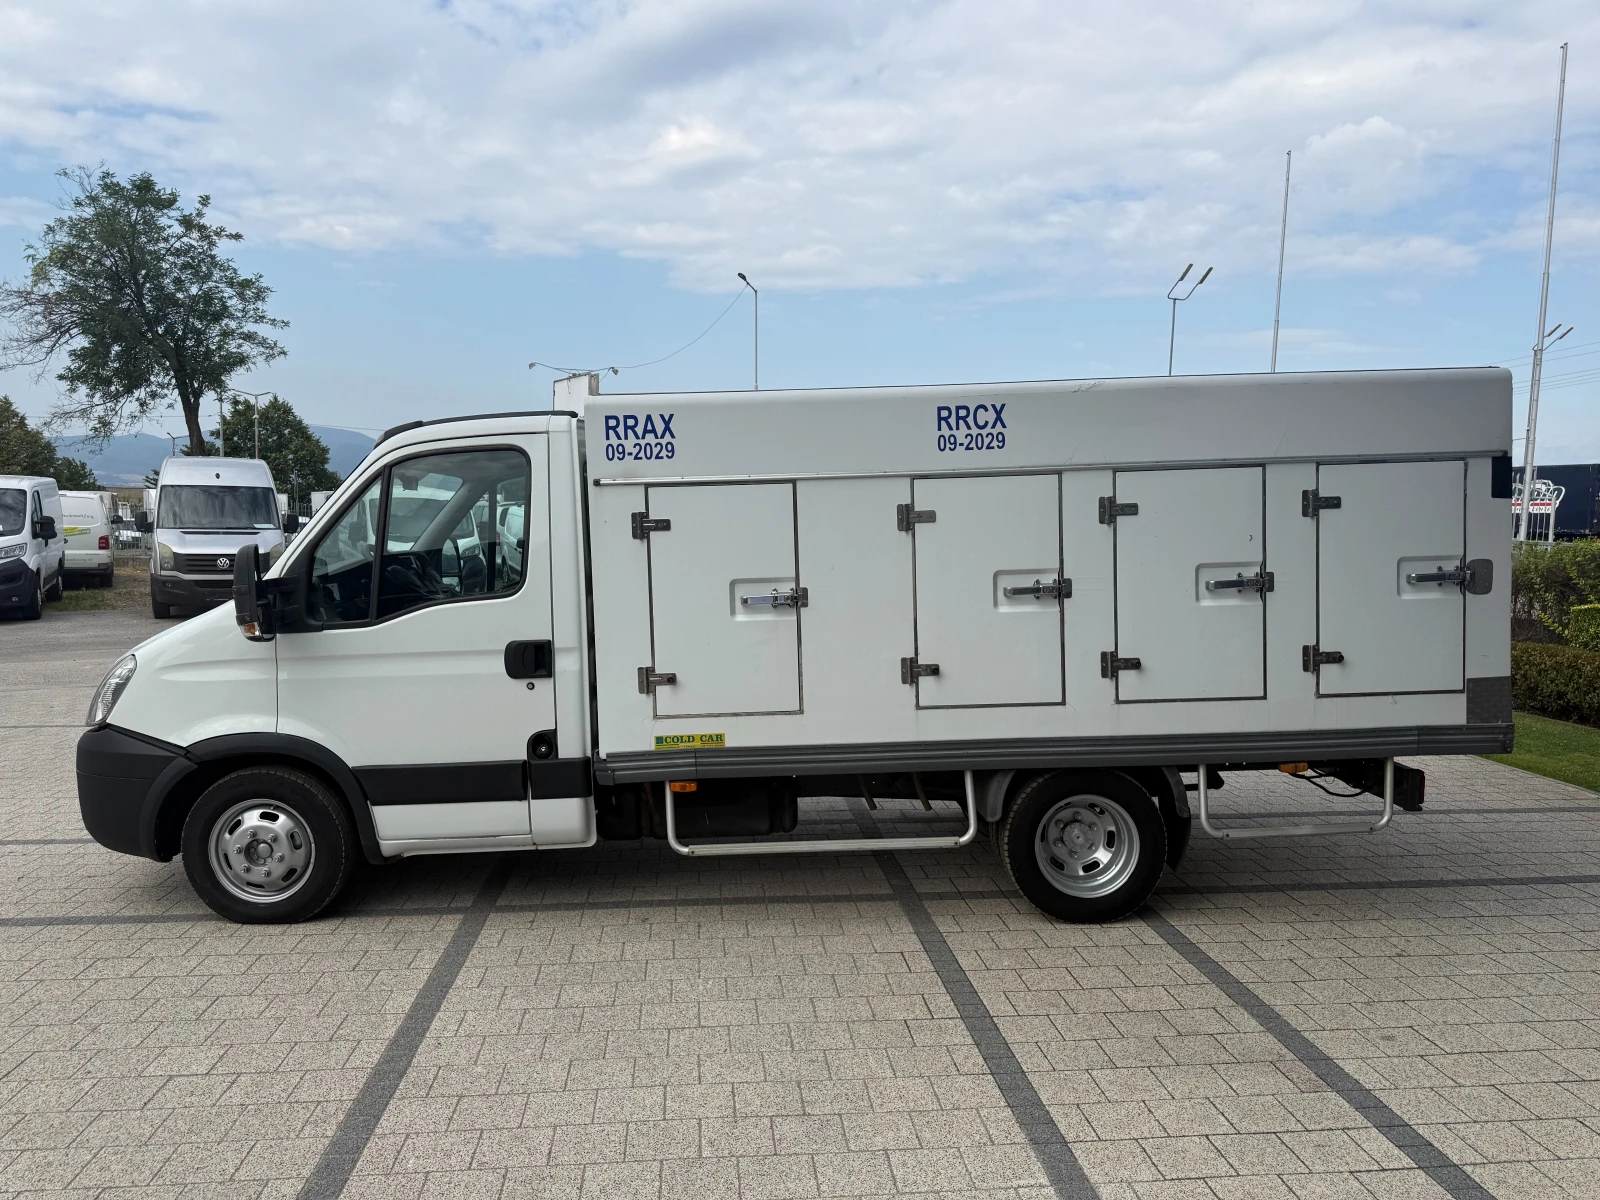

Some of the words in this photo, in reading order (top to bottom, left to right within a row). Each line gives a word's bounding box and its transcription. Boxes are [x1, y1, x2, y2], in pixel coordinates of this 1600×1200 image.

[604, 413, 676, 440] RRAX
[936, 403, 1007, 431] RRCX
[605, 441, 675, 461] 09-2029
[937, 431, 1006, 452] 09-2029
[664, 735, 695, 743] COLD
[700, 734, 723, 742] CAR
